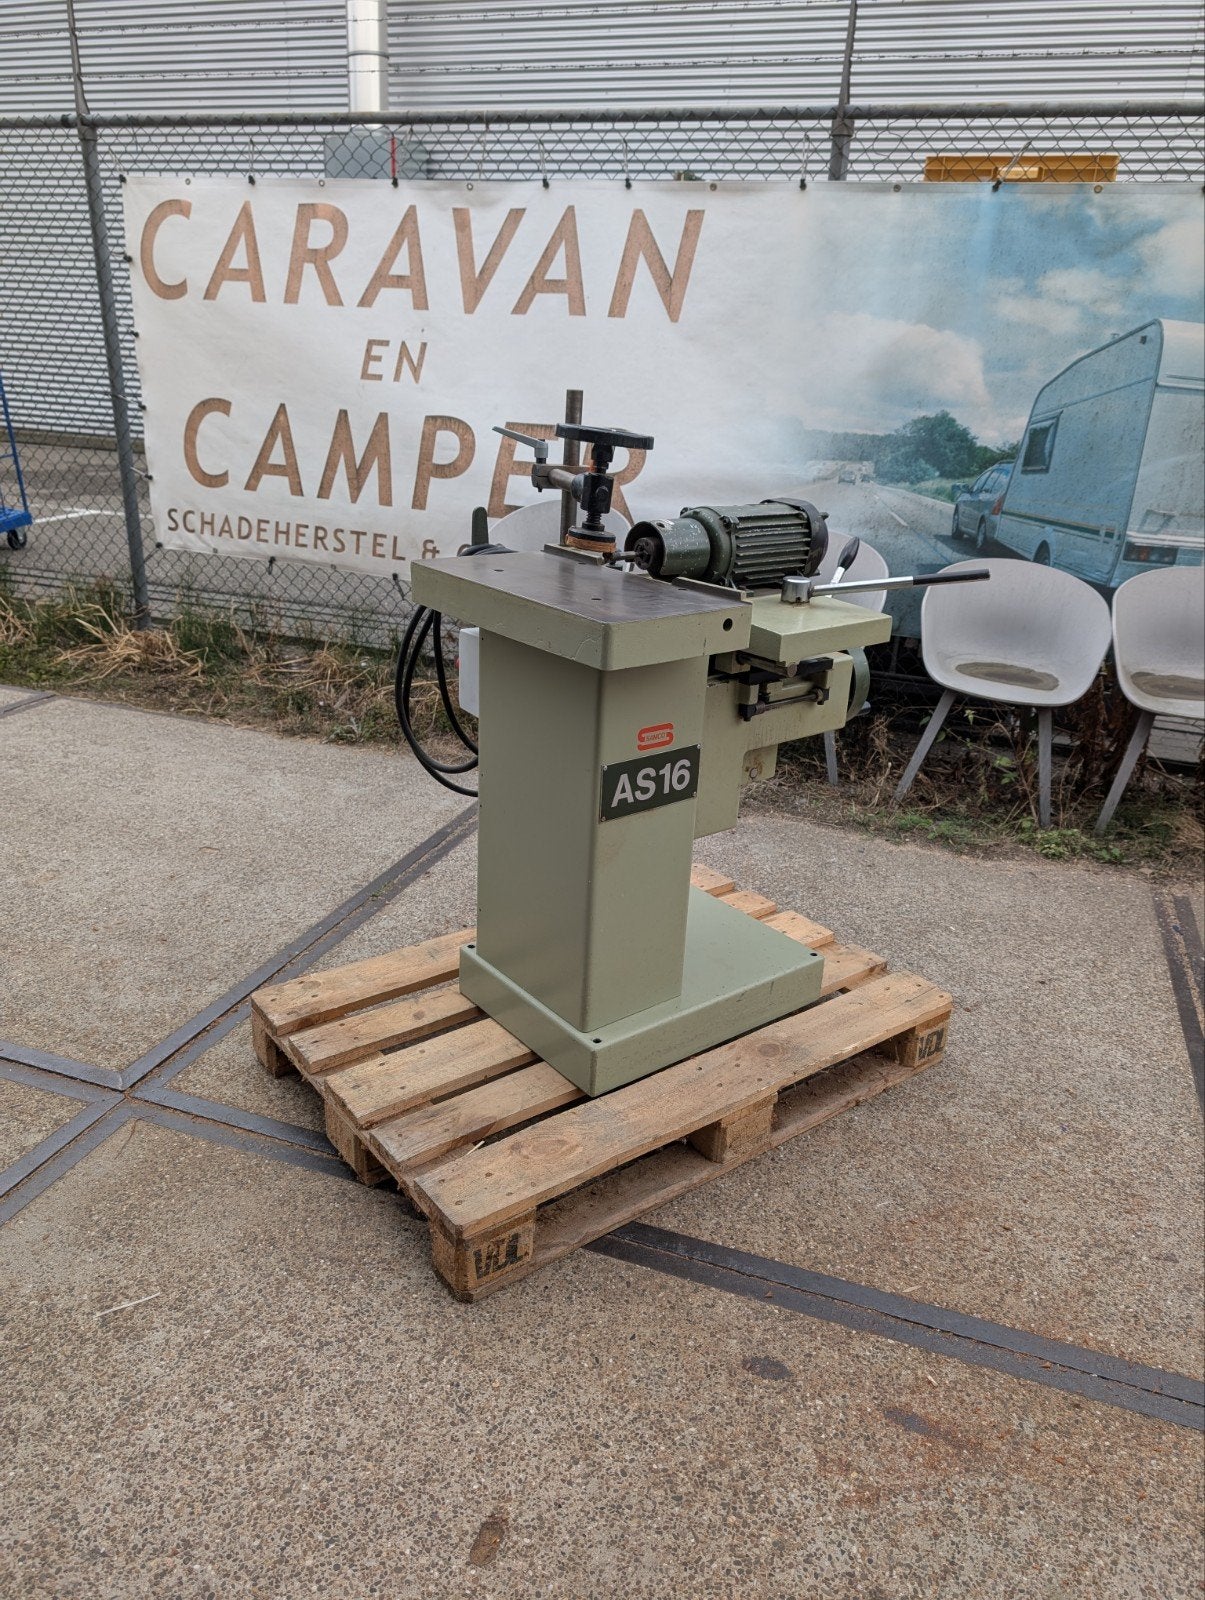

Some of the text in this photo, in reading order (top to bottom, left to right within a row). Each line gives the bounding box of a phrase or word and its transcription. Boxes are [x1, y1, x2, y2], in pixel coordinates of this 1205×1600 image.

[140, 198, 705, 323] CARAVAN
[359, 338, 429, 385] EN
[167, 508, 406, 561] SCHADEHERSTEL
[421, 539, 440, 560] &
[610, 758, 691, 808] AS16
